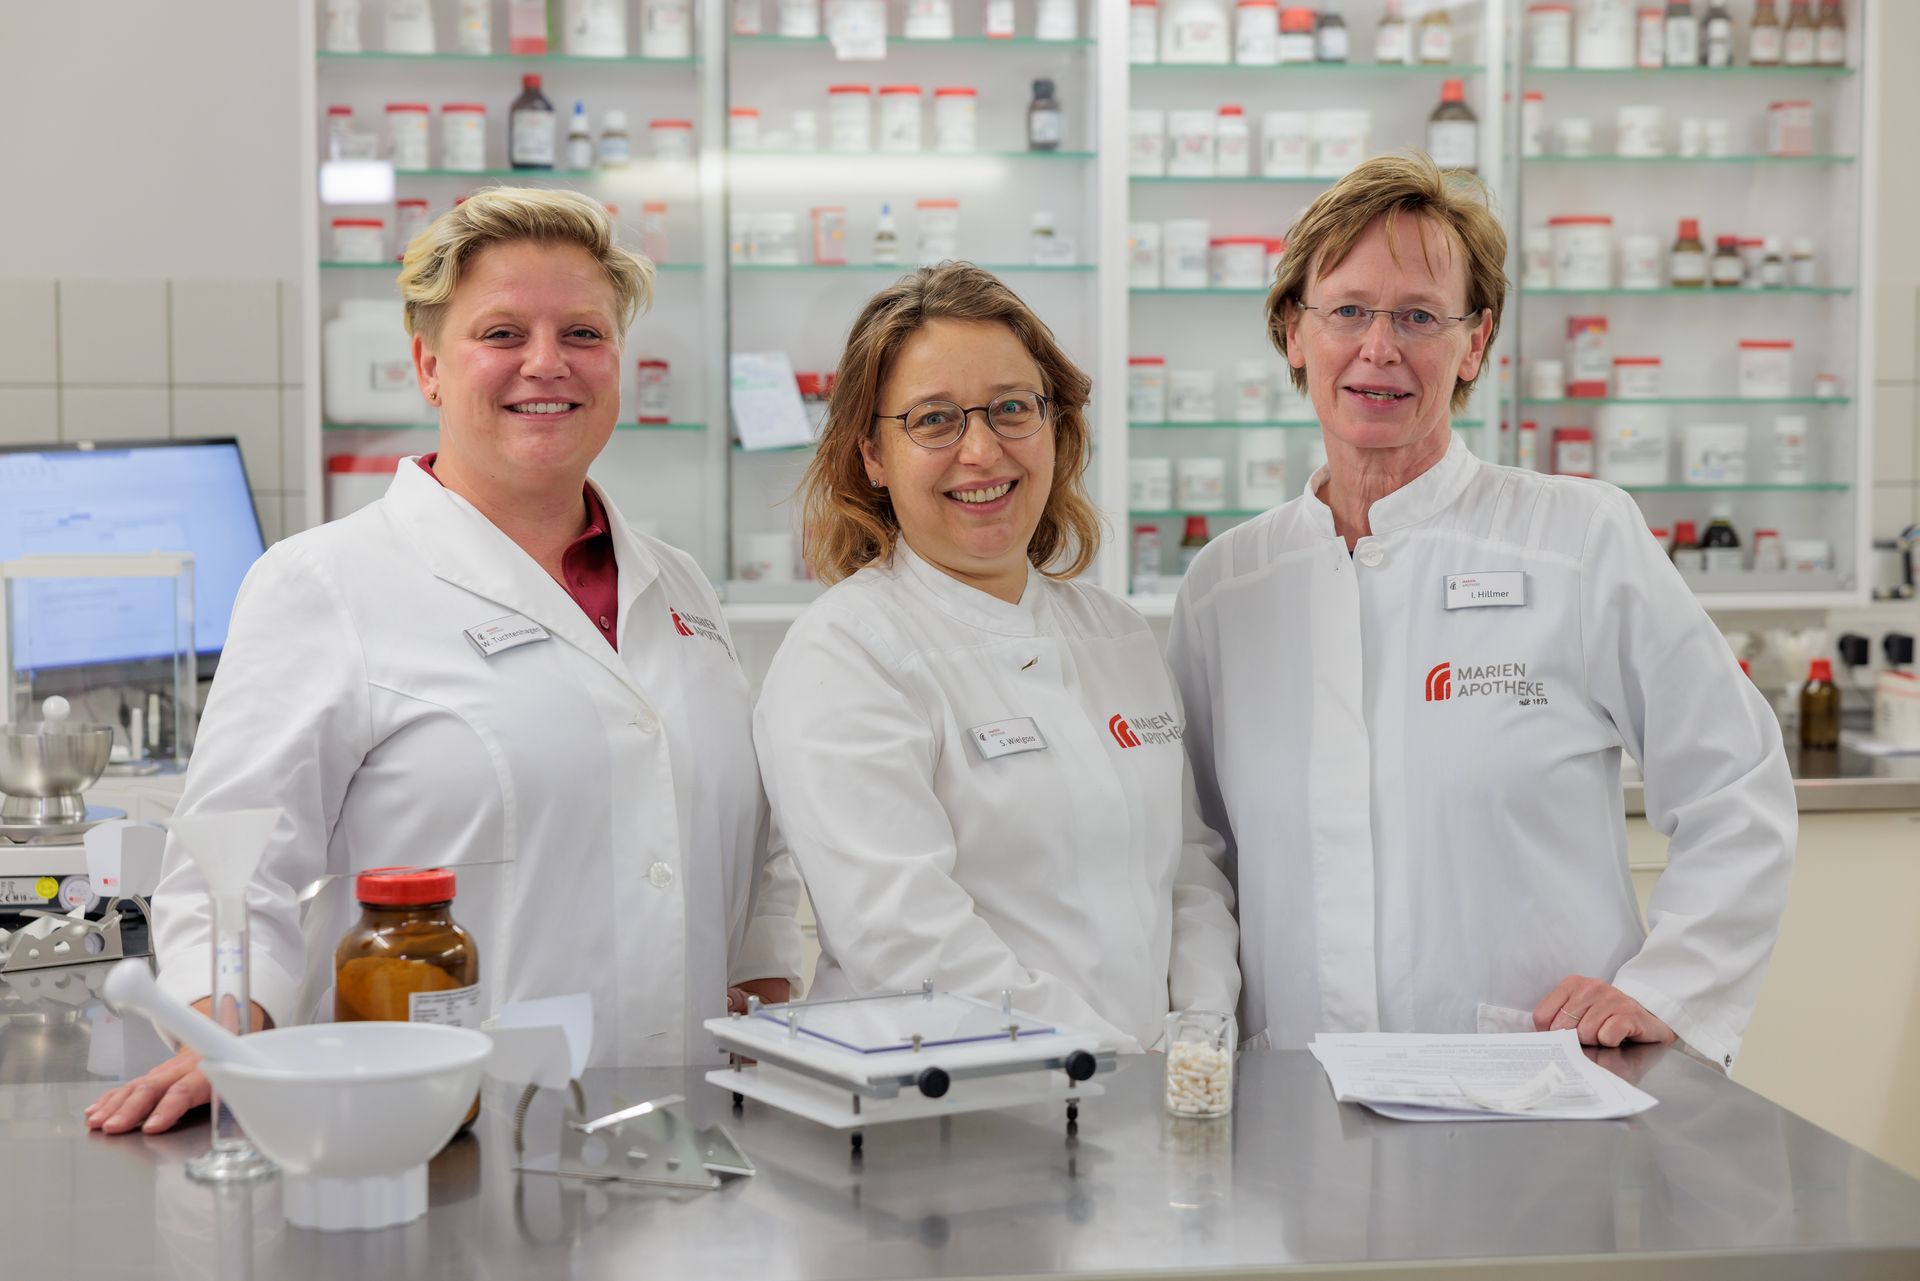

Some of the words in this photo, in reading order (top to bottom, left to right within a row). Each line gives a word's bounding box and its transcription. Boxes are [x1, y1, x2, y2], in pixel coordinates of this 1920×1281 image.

[1477, 590, 1509, 598] Hillmer
[1457, 663, 1526, 680] MARIEN
[1457, 680, 1545, 698] APOTHEKE
